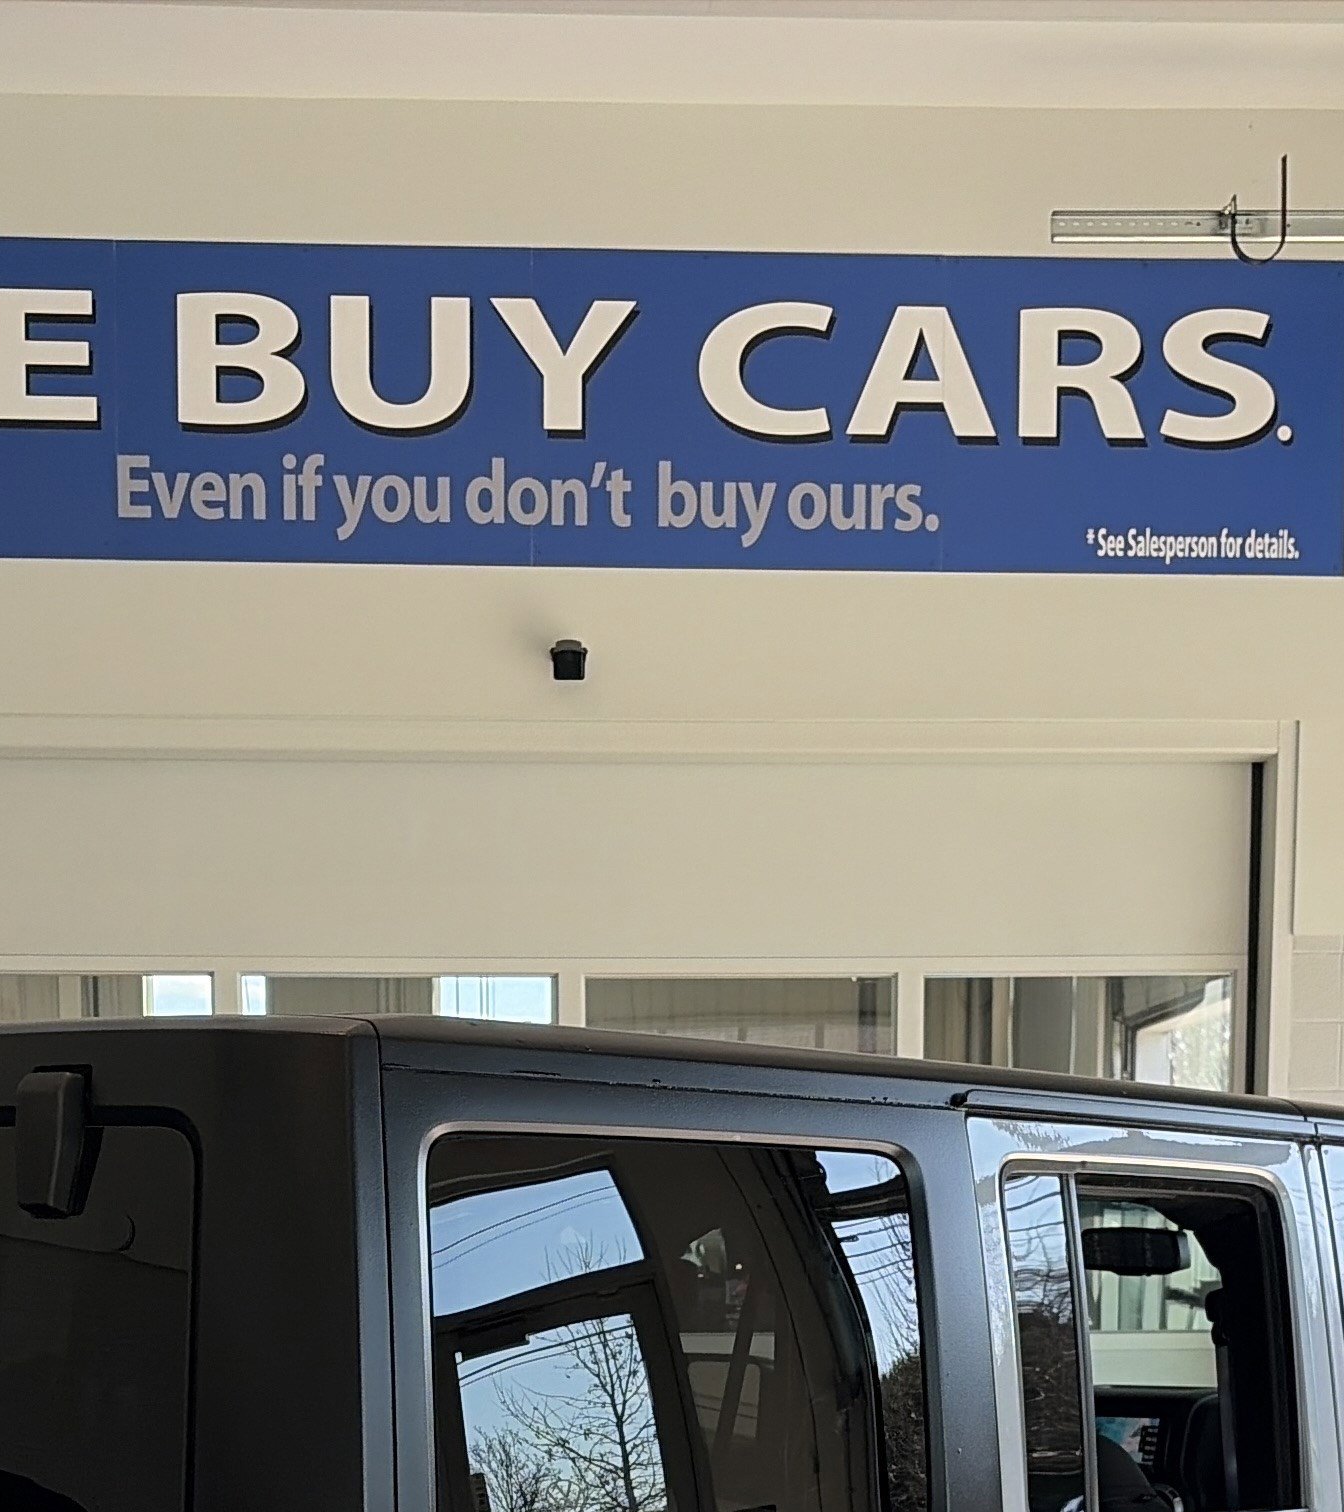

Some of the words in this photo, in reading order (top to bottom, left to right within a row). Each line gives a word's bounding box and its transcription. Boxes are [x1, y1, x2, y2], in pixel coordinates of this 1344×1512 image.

[176, 292, 639, 438] BUY
[698, 301, 1294, 449] CARS.
[117, 455, 266, 520] Even
[282, 453, 325, 521] if
[333, 474, 450, 541] you
[465, 457, 632, 527] don’t
[658, 460, 777, 548] buy
[788, 482, 940, 532] ours.
[1127, 527, 1218, 565] Salesperson
[1220, 528, 1243, 558] for
[1245, 528, 1299, 559] details.
